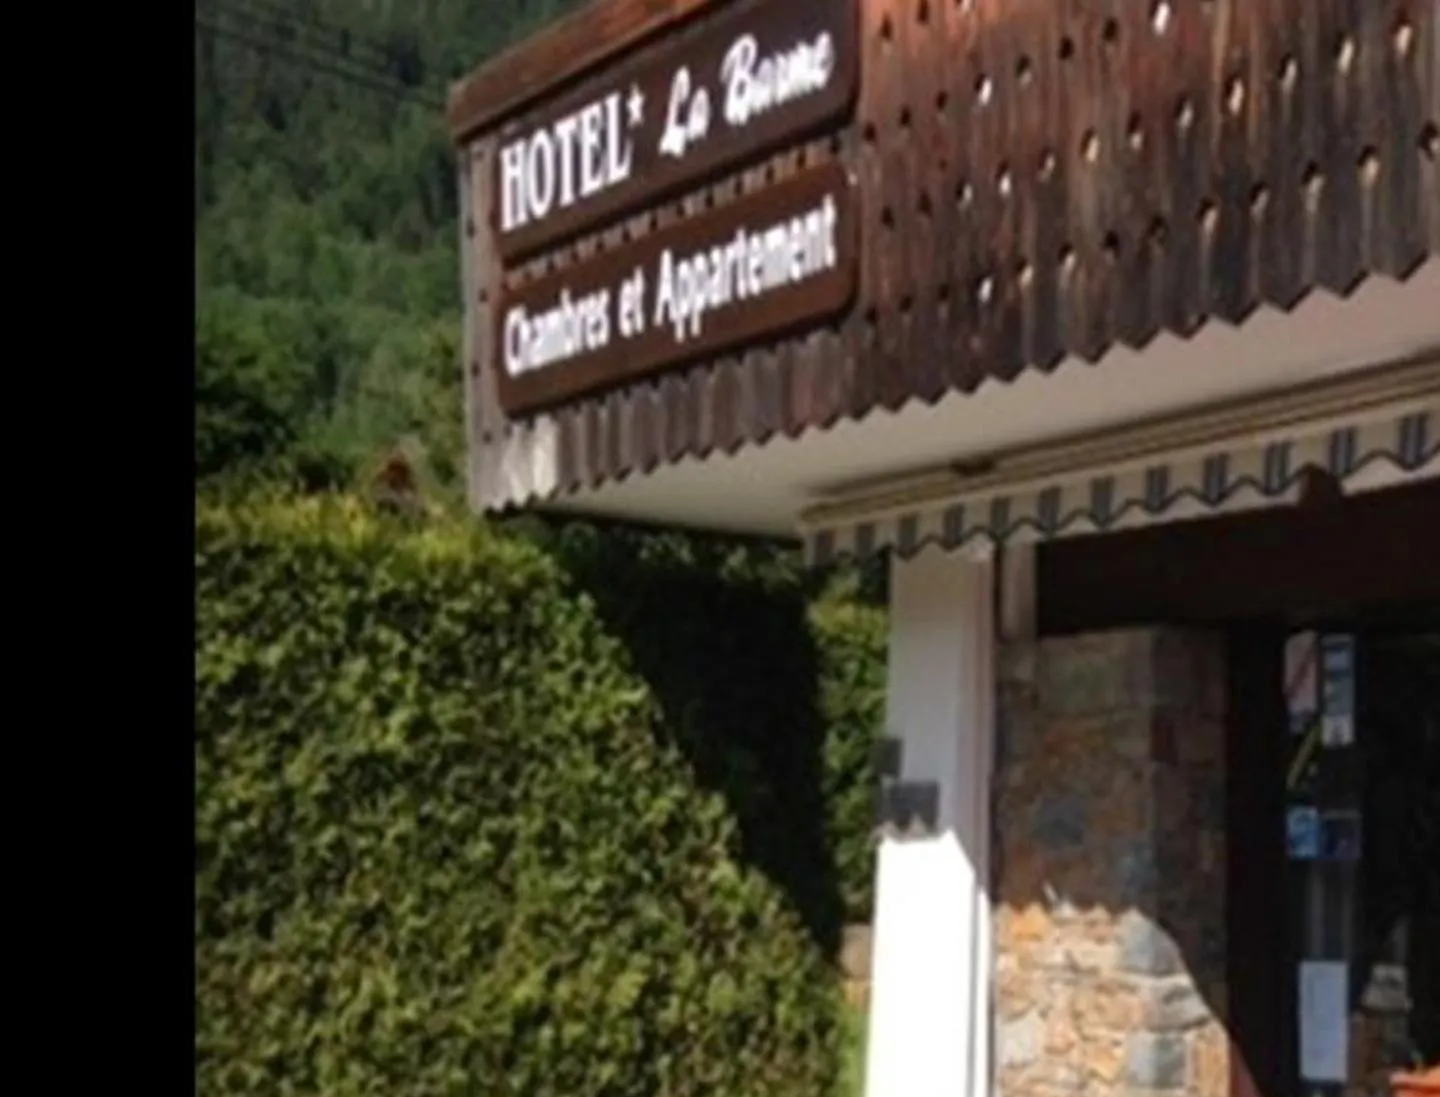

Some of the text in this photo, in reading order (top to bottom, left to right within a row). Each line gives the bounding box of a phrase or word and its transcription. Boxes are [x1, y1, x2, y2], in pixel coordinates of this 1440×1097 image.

[501, 92, 634, 233] HOTEL
[659, 65, 711, 157] La
[504, 193, 837, 377] Chambres et Appartement
